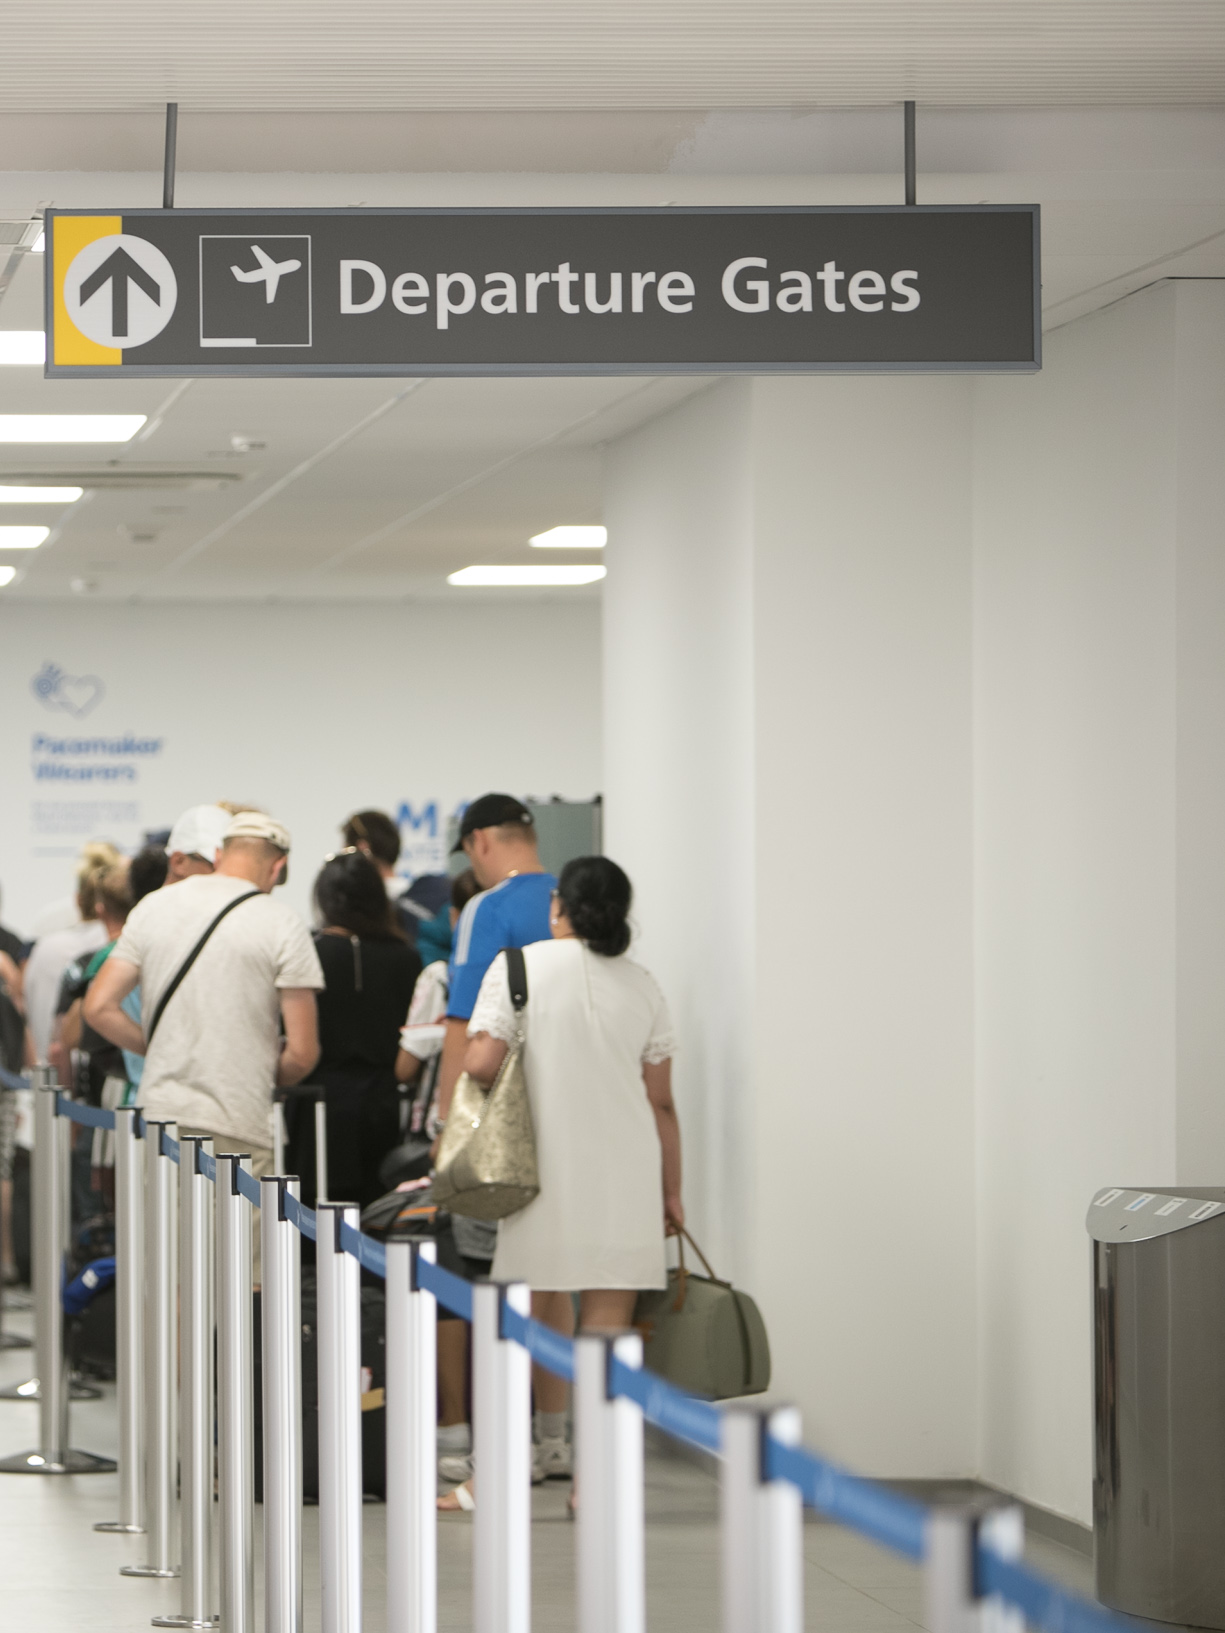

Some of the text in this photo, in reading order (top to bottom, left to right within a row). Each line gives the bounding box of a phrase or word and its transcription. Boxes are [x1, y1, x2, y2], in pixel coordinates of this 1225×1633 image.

[338, 256, 921, 330] Departure Gates
[32, 732, 163, 756] Pacemaker
[32, 763, 136, 782] Wearers
